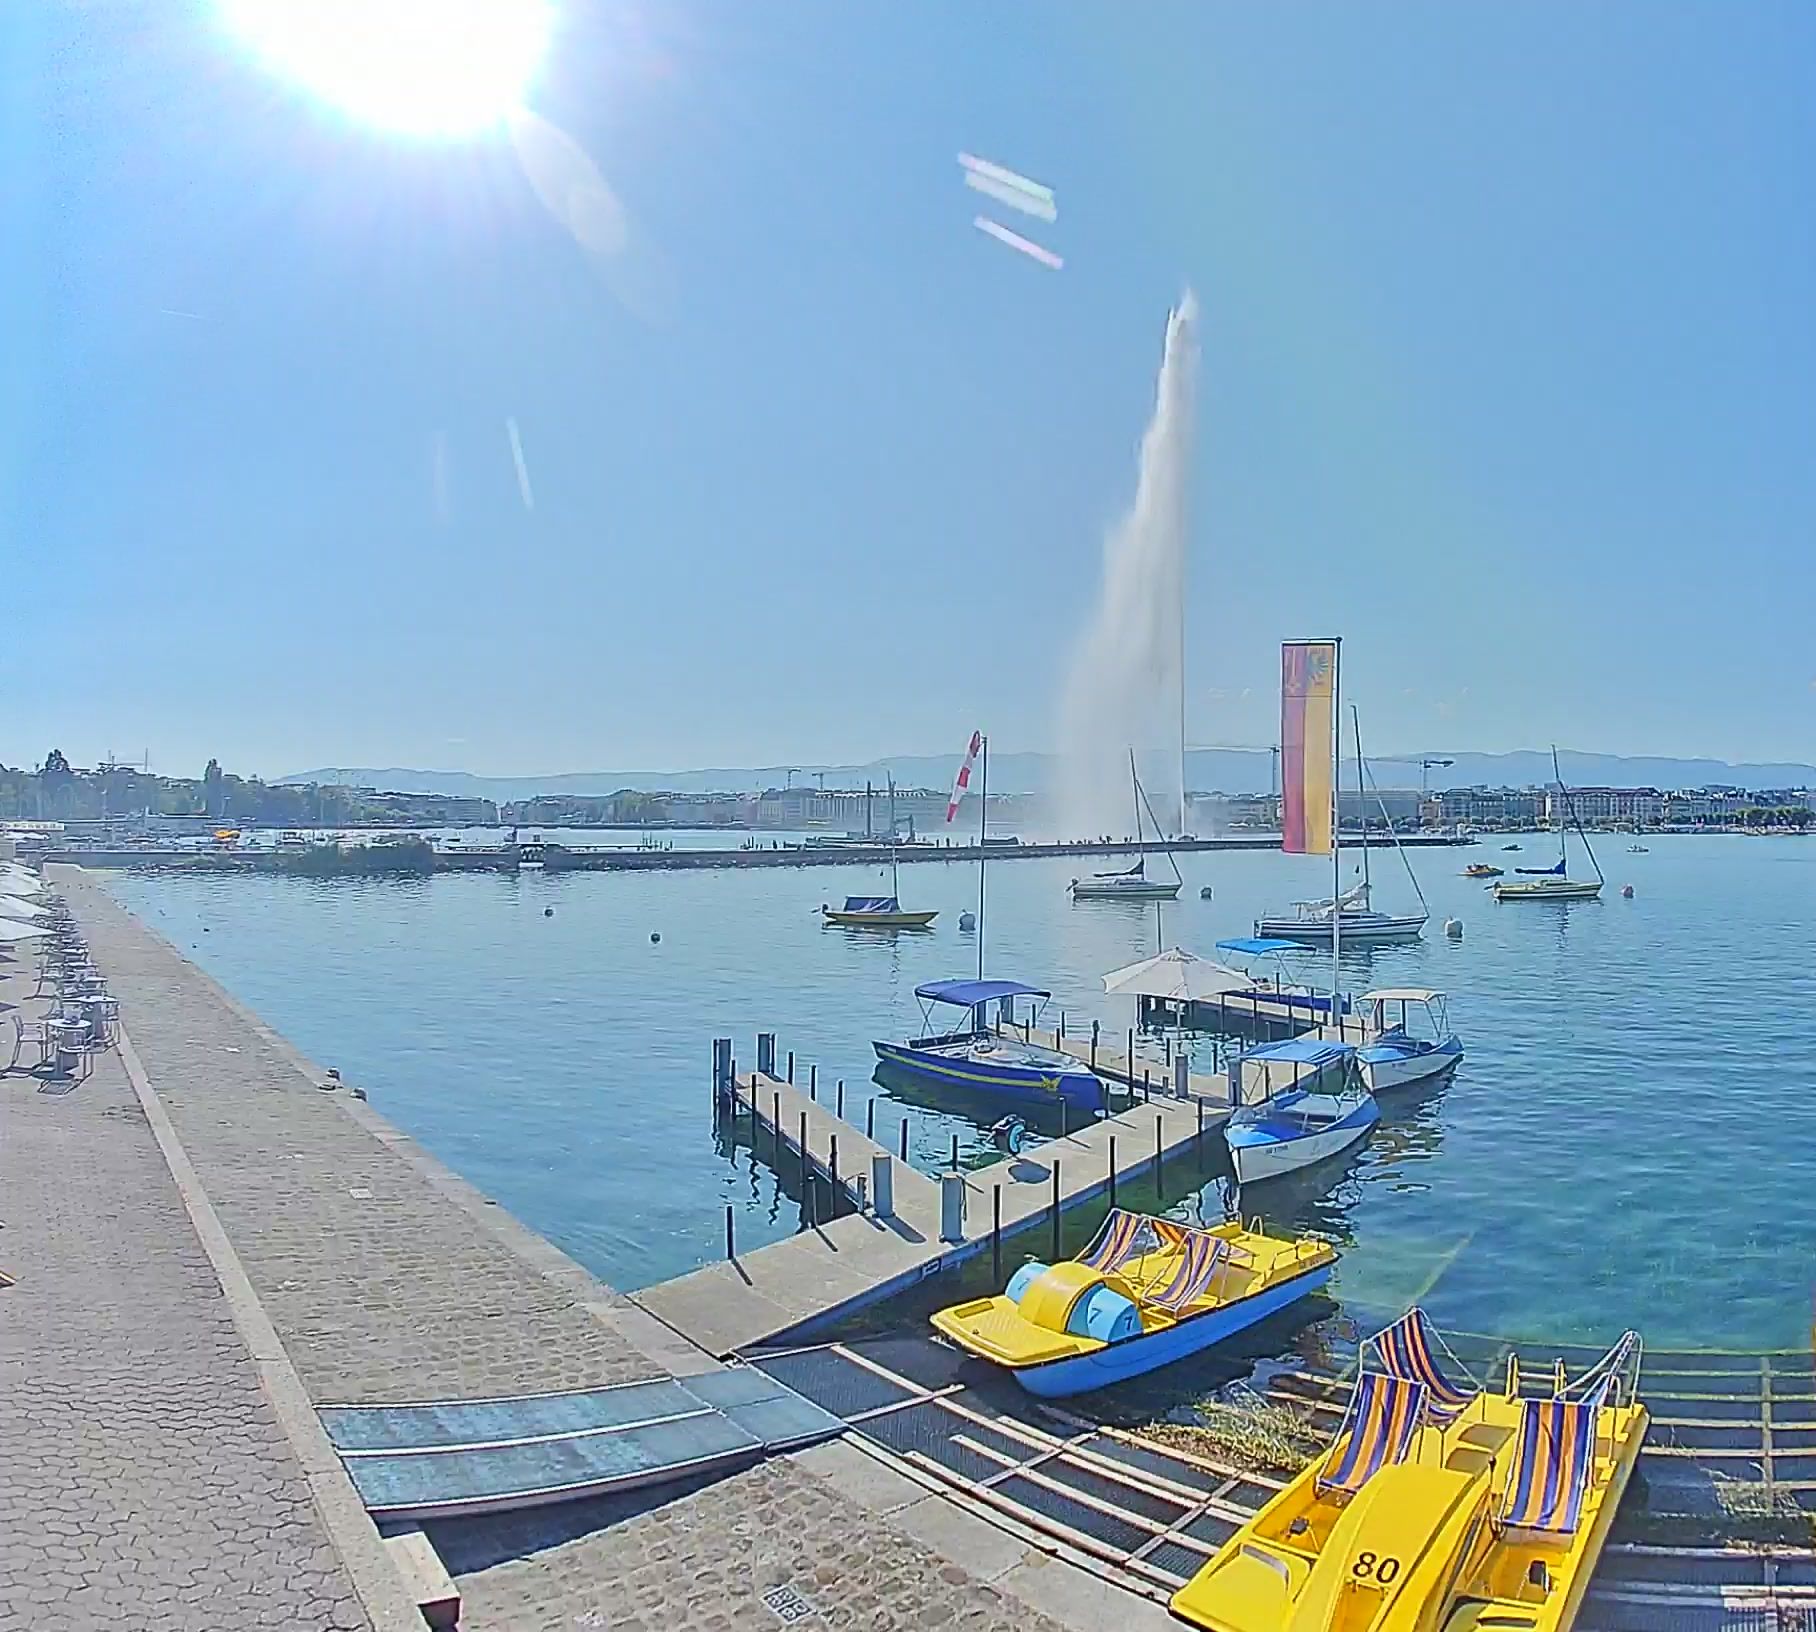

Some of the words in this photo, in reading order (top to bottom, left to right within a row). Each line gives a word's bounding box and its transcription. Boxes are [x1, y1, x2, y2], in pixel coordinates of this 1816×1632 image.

[1089, 1307, 1102, 1323] 7
[1124, 1316, 1133, 1331] 7
[1353, 1552, 1399, 1583] 80
